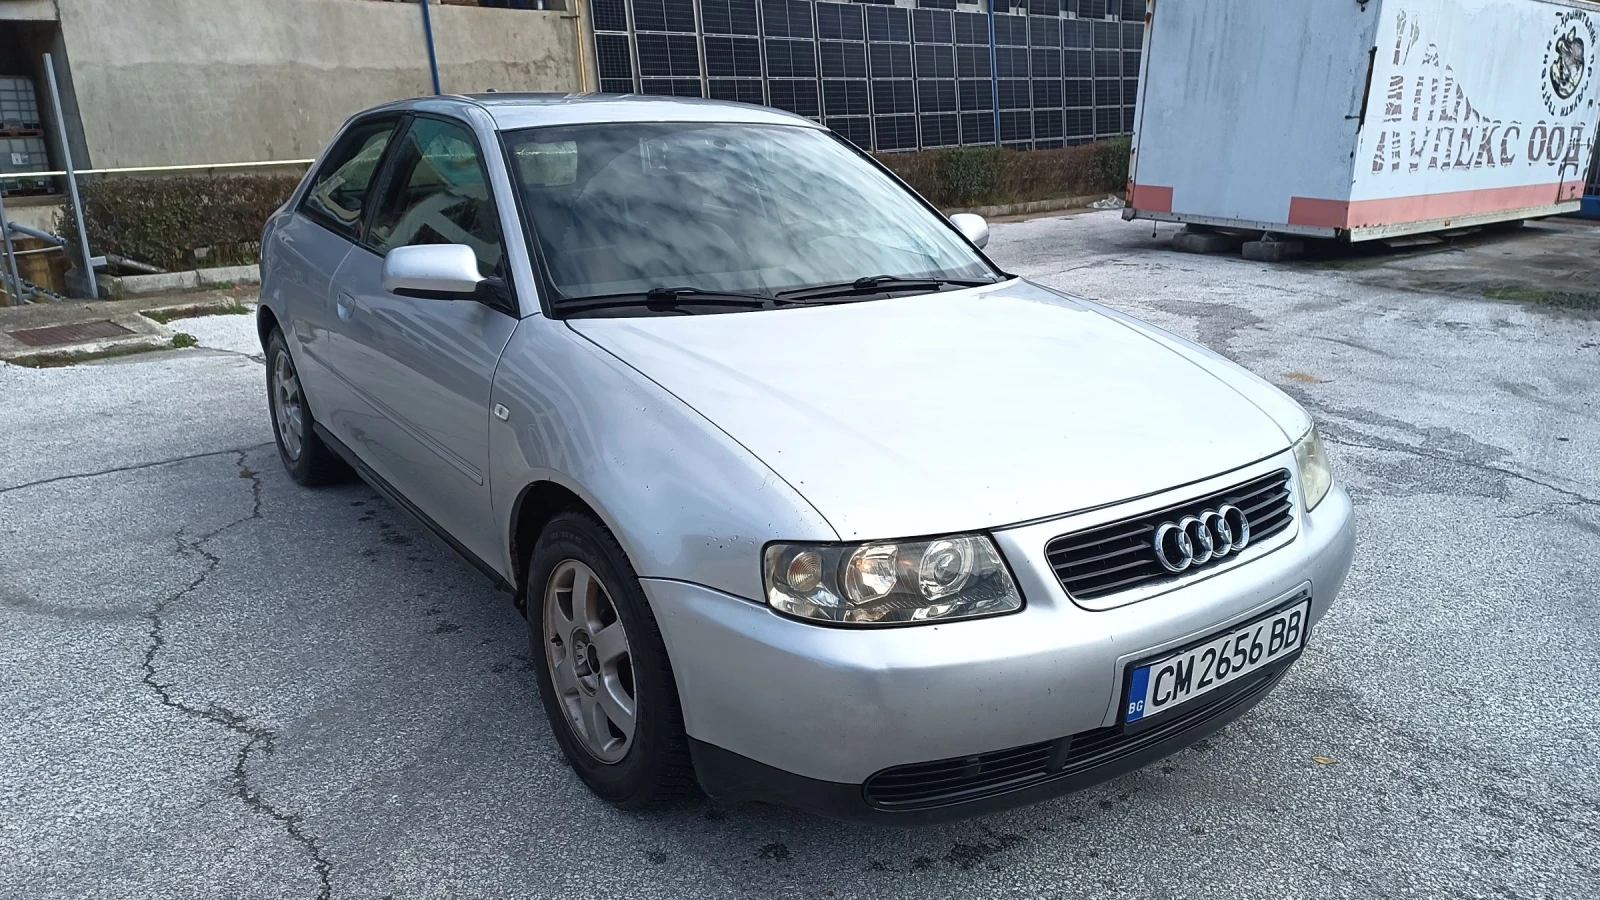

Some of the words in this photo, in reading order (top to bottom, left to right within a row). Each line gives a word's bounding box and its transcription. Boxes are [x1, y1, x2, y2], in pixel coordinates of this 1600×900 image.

[1152, 654, 1195, 707] CM
[1196, 625, 1264, 690] 2656
[1267, 610, 1302, 658] BB
[1128, 700, 1143, 715] BG
